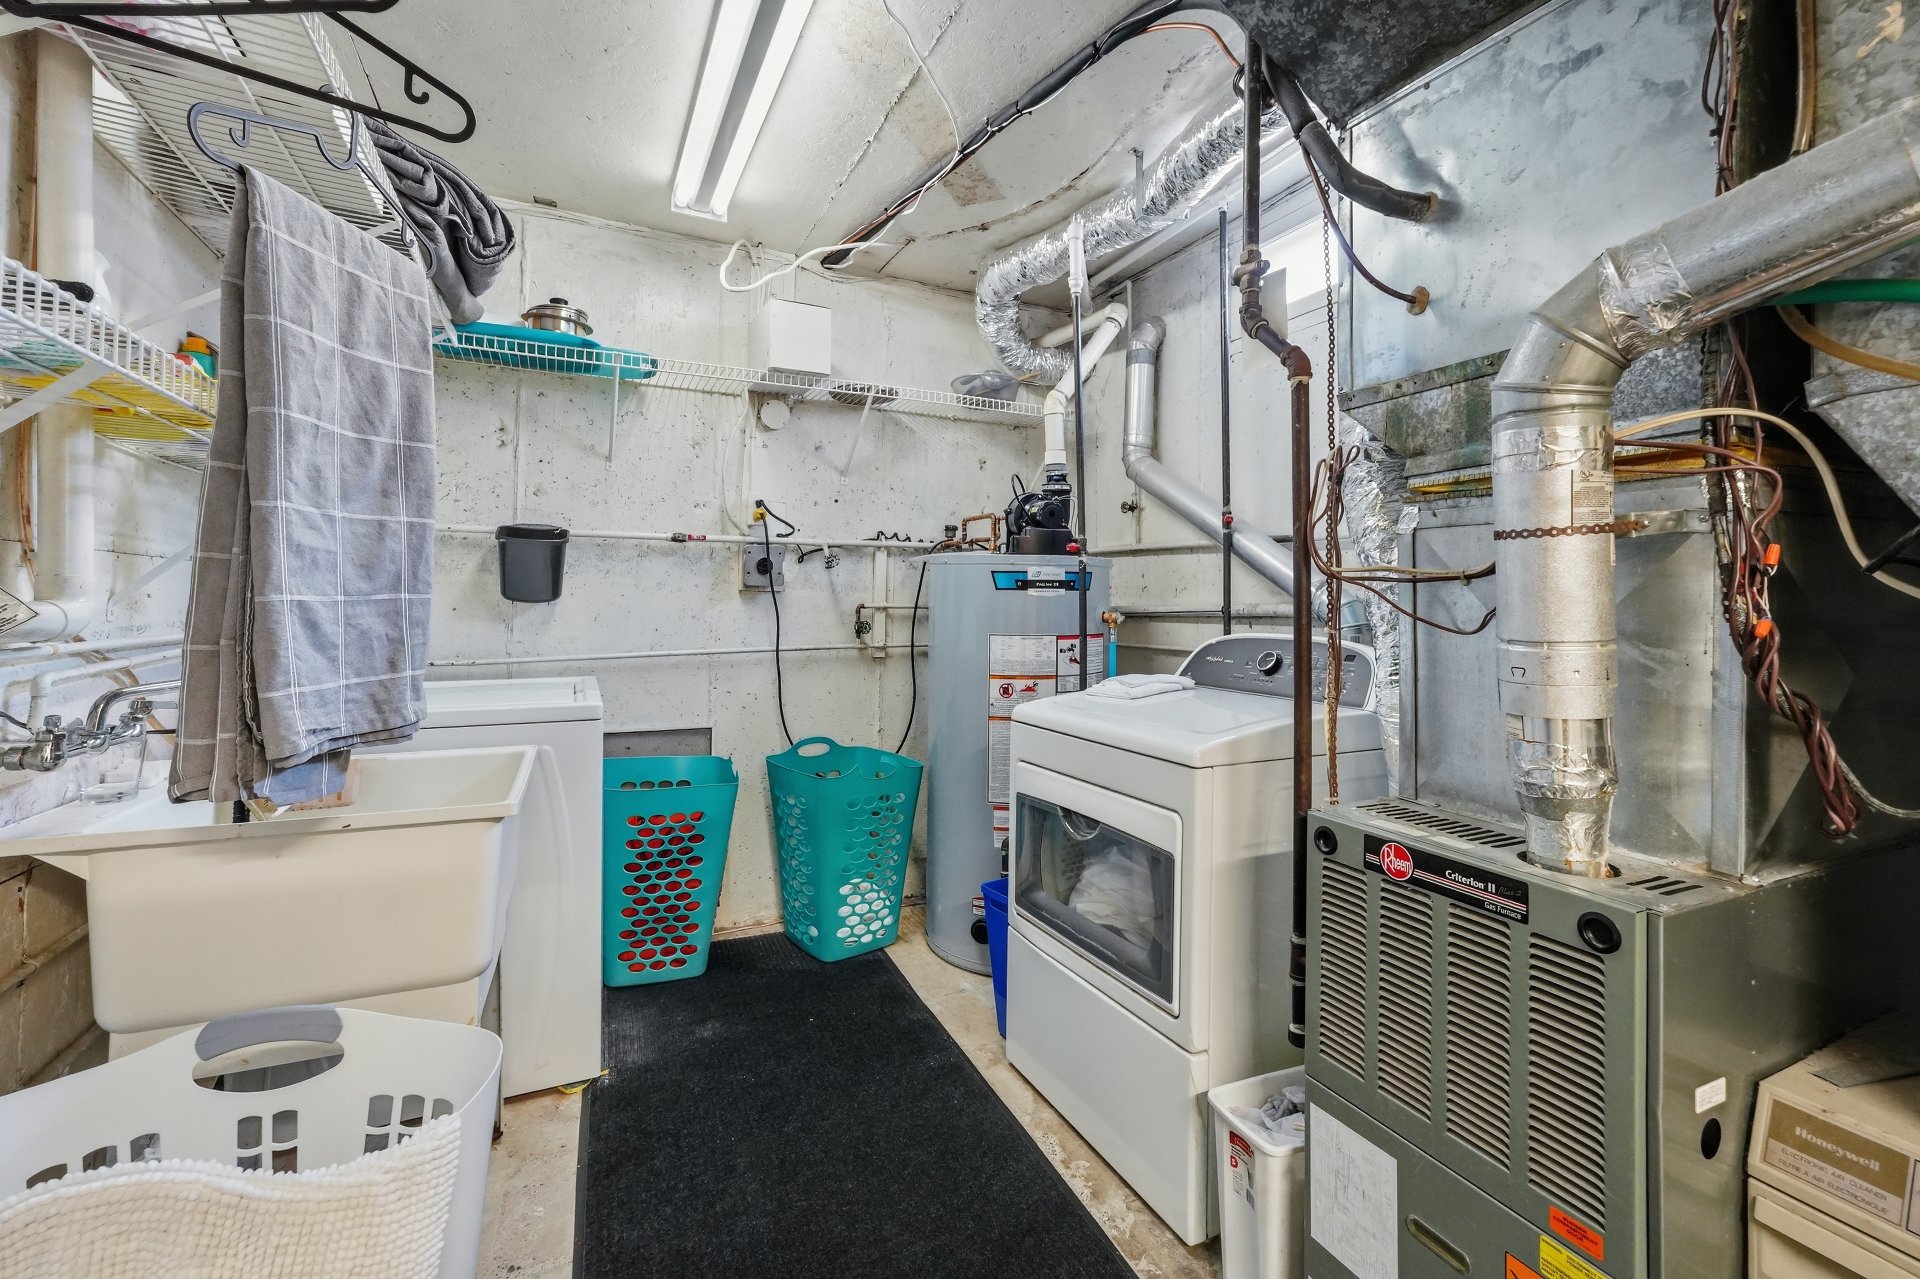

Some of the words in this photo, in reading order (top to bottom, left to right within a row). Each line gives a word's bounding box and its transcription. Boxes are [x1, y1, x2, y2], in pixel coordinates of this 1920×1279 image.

[1383, 844, 1412, 875] Rheem
[1445, 869, 1485, 890] Criterion
[1487, 882, 1496, 894] II
[1484, 901, 1496, 912] Gas
[1497, 905, 1522, 920] Furnace
[1795, 1126, 1880, 1172] Honeywell
[1779, 1158, 1801, 1174] FILTRE
[1811, 1173, 1825, 1185] AIR
[1827, 1181, 1888, 1215] ELECTRONIQUE
[1781, 1147, 1829, 1174] ELECTRONIC
[1830, 1169, 1846, 1182] AIR
[1850, 1180, 1887, 1201] CLEANER
